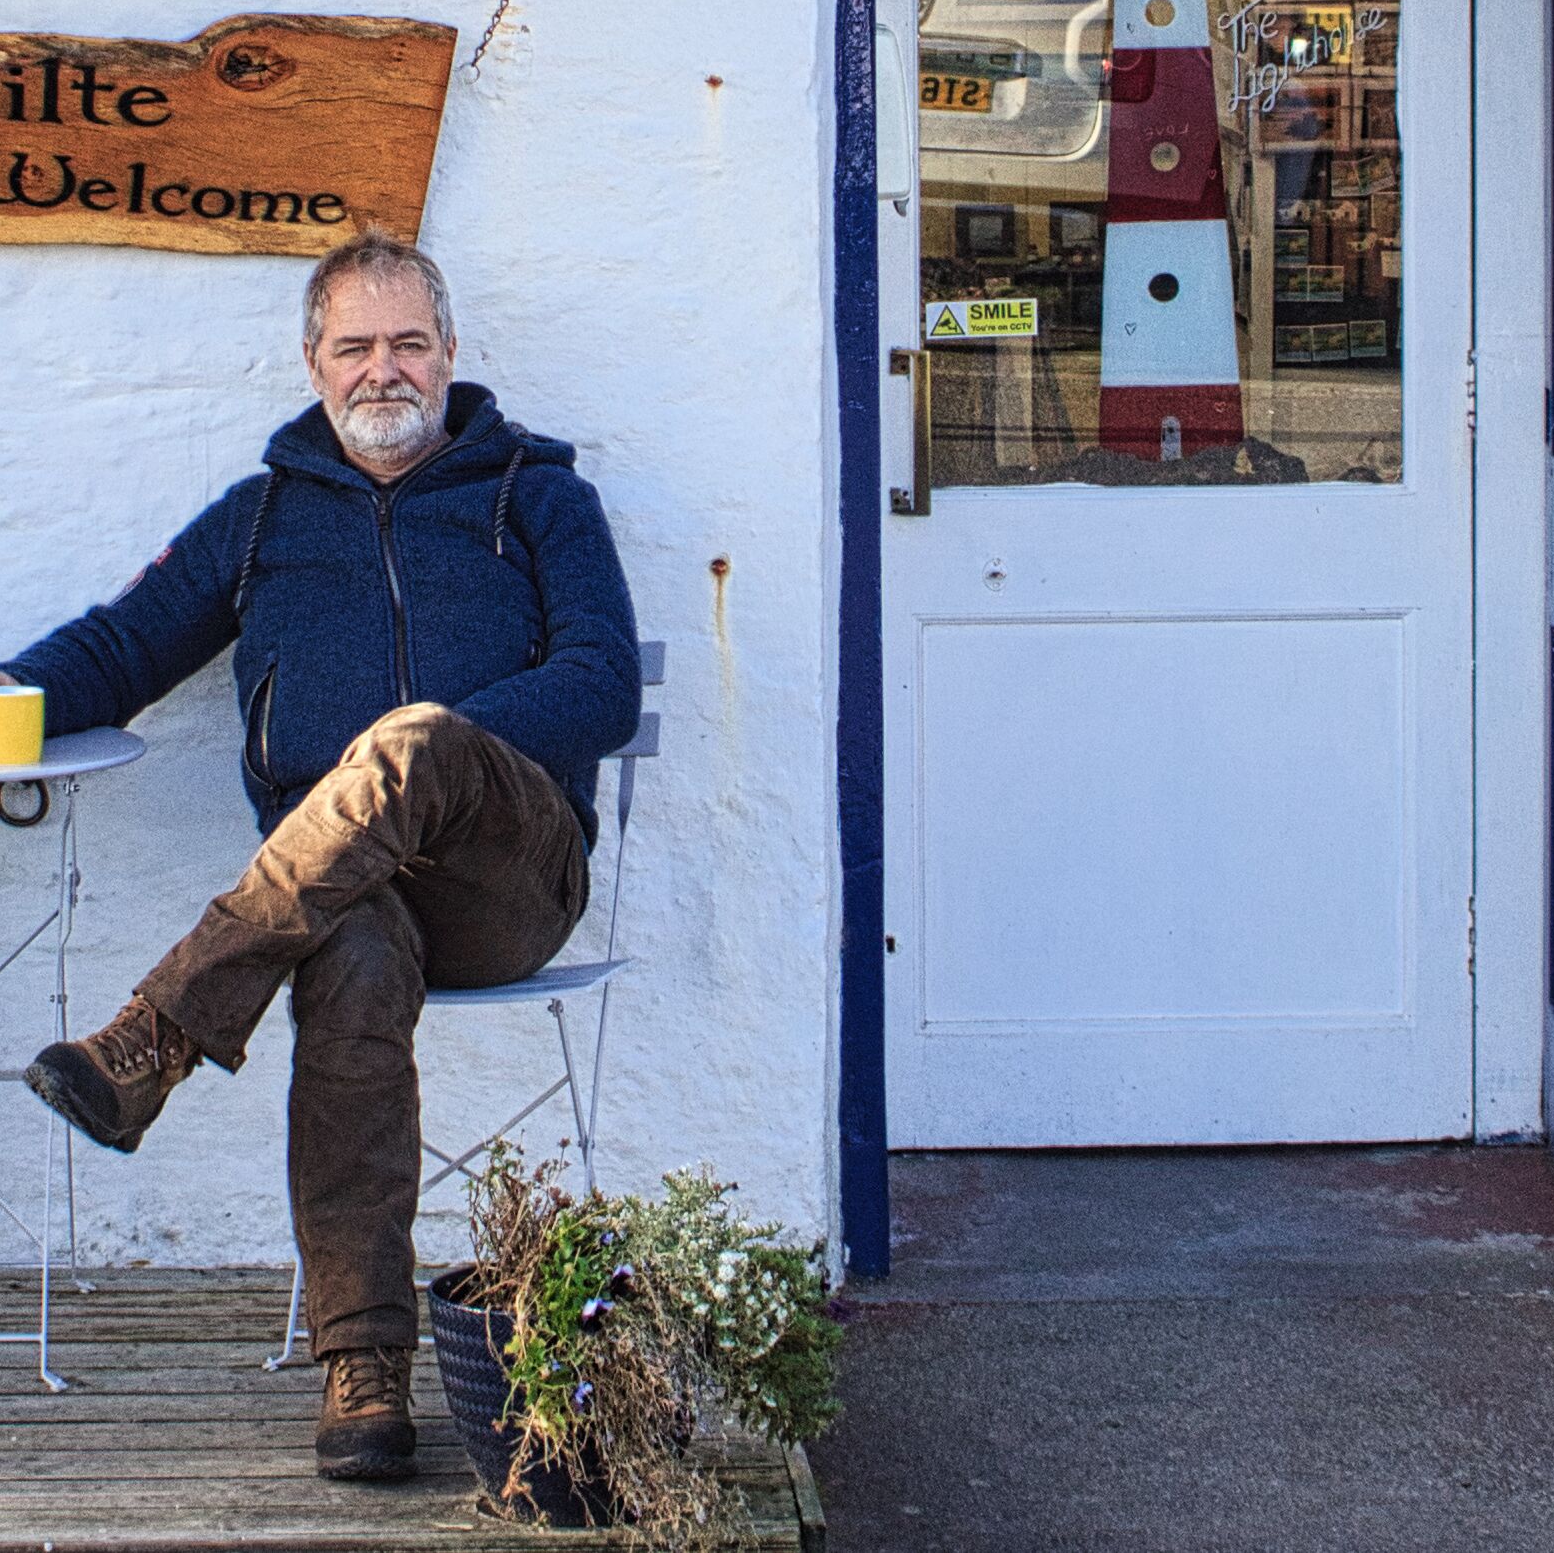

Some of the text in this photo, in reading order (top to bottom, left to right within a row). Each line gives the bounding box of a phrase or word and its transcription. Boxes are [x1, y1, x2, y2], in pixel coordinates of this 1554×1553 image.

[970, 302, 1032, 319] SMILE
[971, 324, 996, 332] You're
[1010, 323, 1032, 331] CCTV
